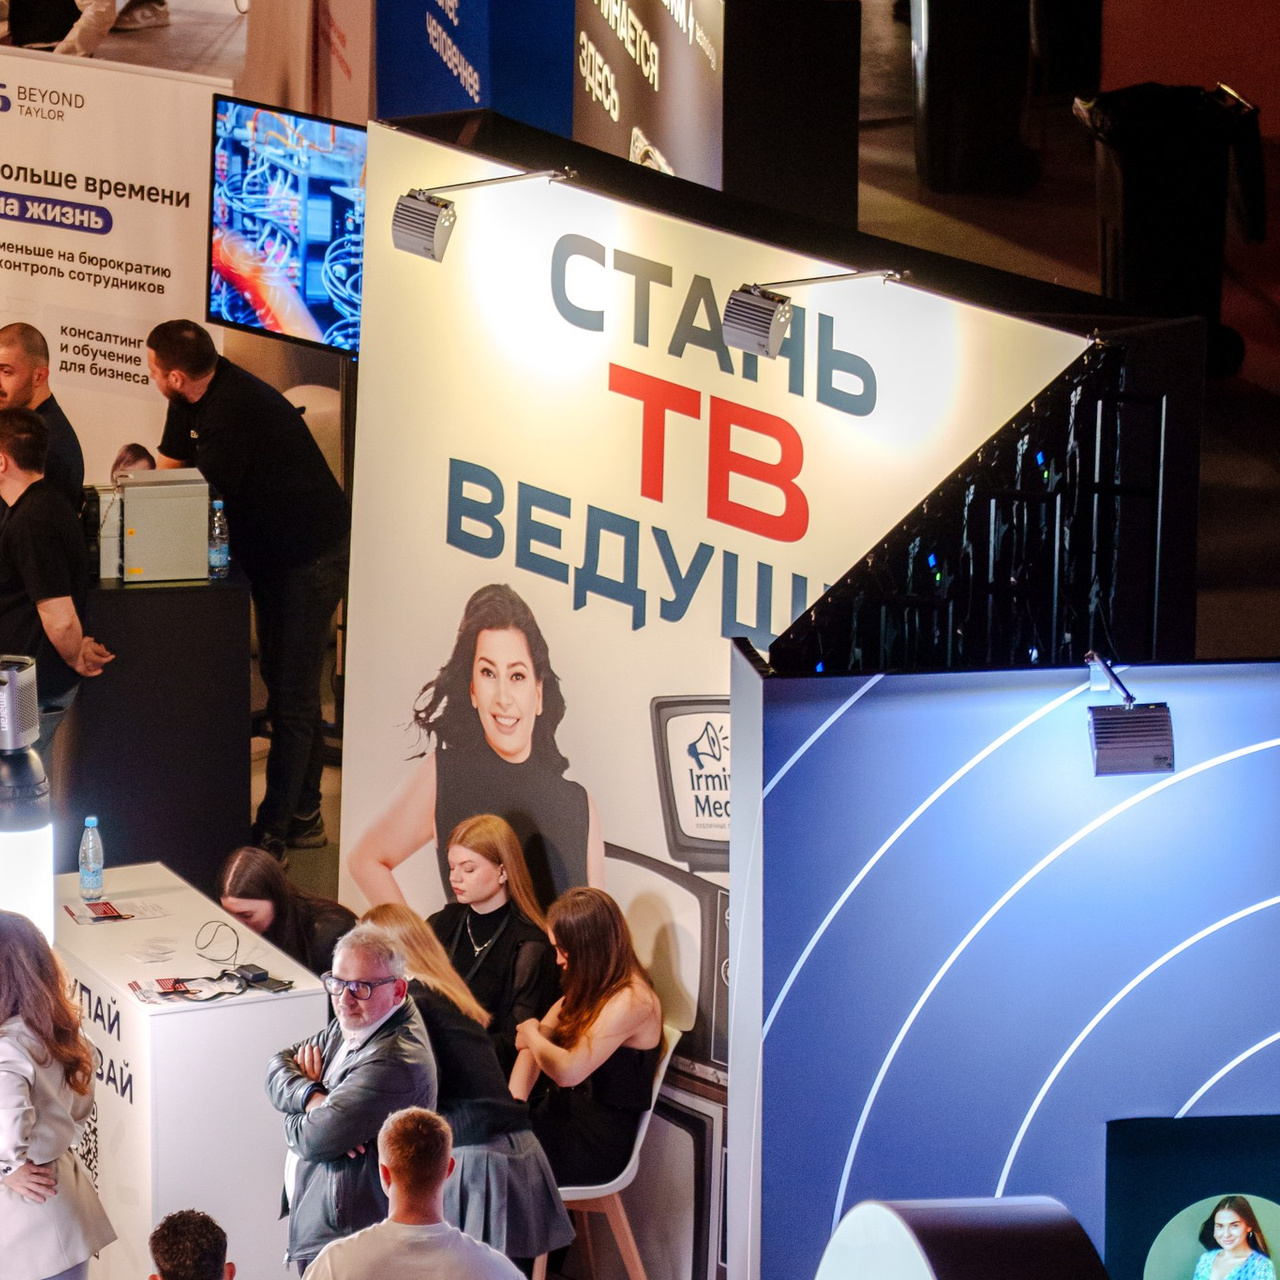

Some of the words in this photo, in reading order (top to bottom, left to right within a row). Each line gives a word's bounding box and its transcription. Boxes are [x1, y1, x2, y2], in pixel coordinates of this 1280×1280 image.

[426, 11, 480, 104] человечнее
[579, 31, 620, 122] ЗДЕСЬ
[17, 86, 85, 109] BEYOND
[17, 104, 65, 122] TAYLOR
[84, 176, 190, 208] времени
[25, 200, 104, 230] жизнь
[57, 250, 75, 263] на
[78, 251, 171, 279] бюрократию
[68, 269, 165, 295] сотрудников
[60, 325, 144, 349] консалтинг
[60, 342, 69, 353] и
[72, 344, 141, 366] обучение
[59, 360, 85, 374] для
[89, 363, 149, 385] бизнеса
[608, 362, 810, 544] ТВ
[446, 457, 831, 653] ВЕДУЩ
[0, 692, 8, 731] amaran
[689, 766, 730, 791] Irmi
[72, 978, 120, 1042] ПАЙ
